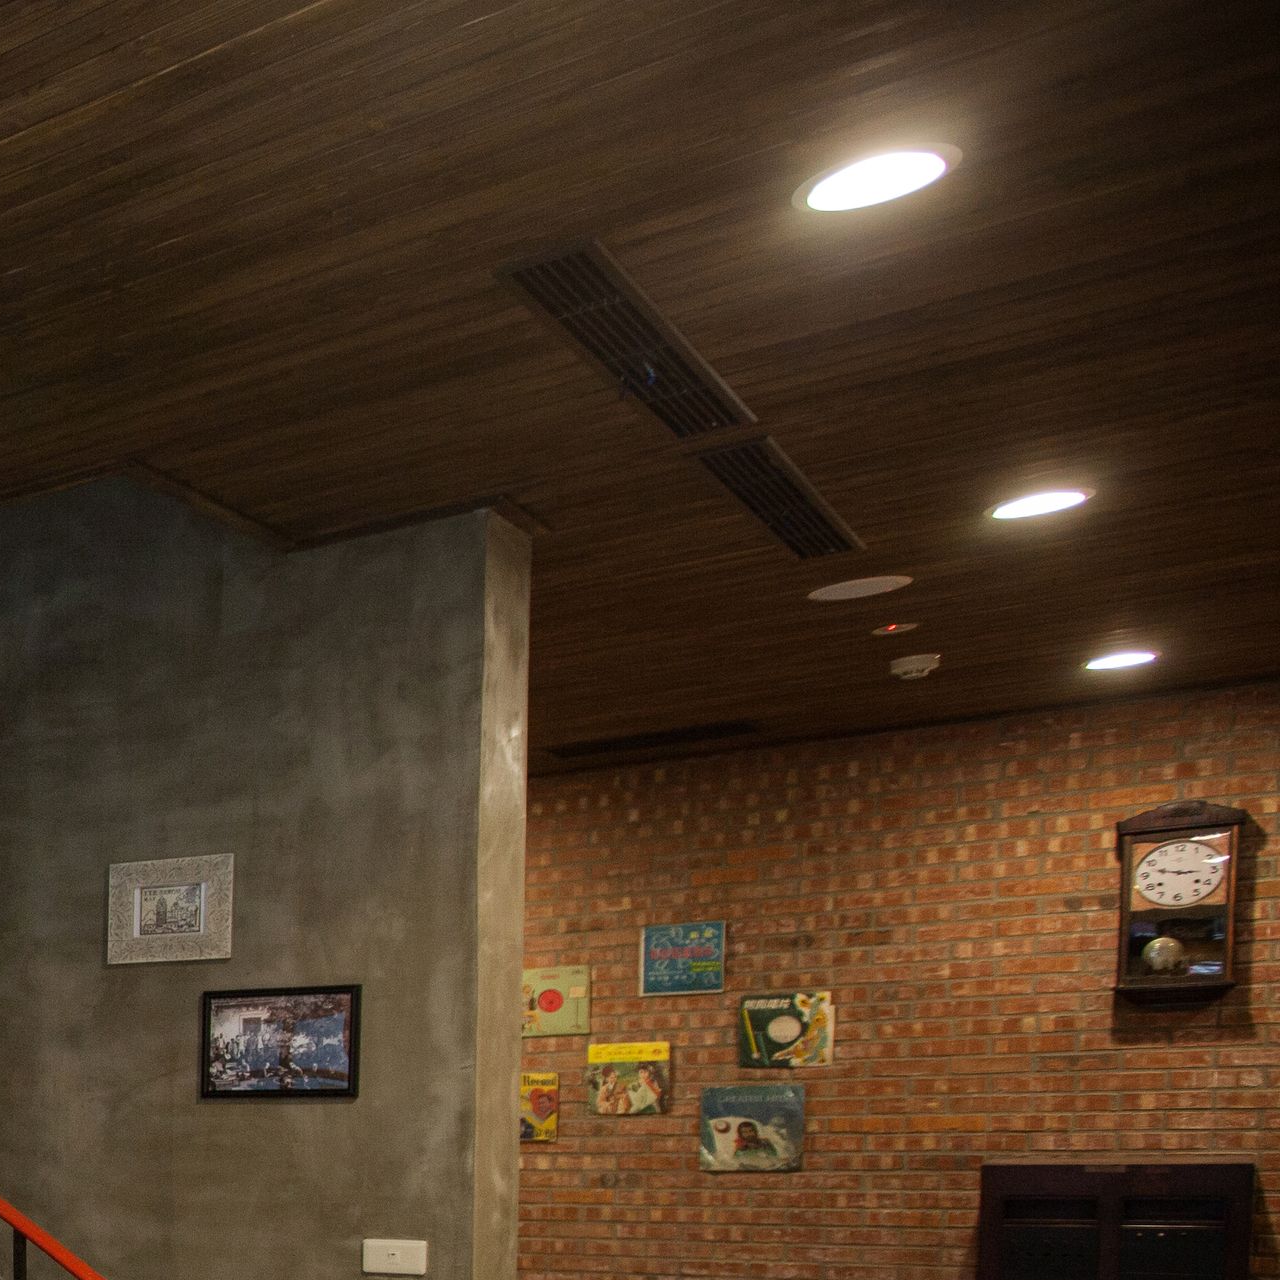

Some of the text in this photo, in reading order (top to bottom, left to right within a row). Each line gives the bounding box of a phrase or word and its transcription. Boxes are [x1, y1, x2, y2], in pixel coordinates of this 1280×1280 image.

[1175, 844, 1186, 852] 12
[1211, 865, 1218, 874] 3
[1140, 872, 1150, 880] 9
[1172, 893, 1183, 901] 6
